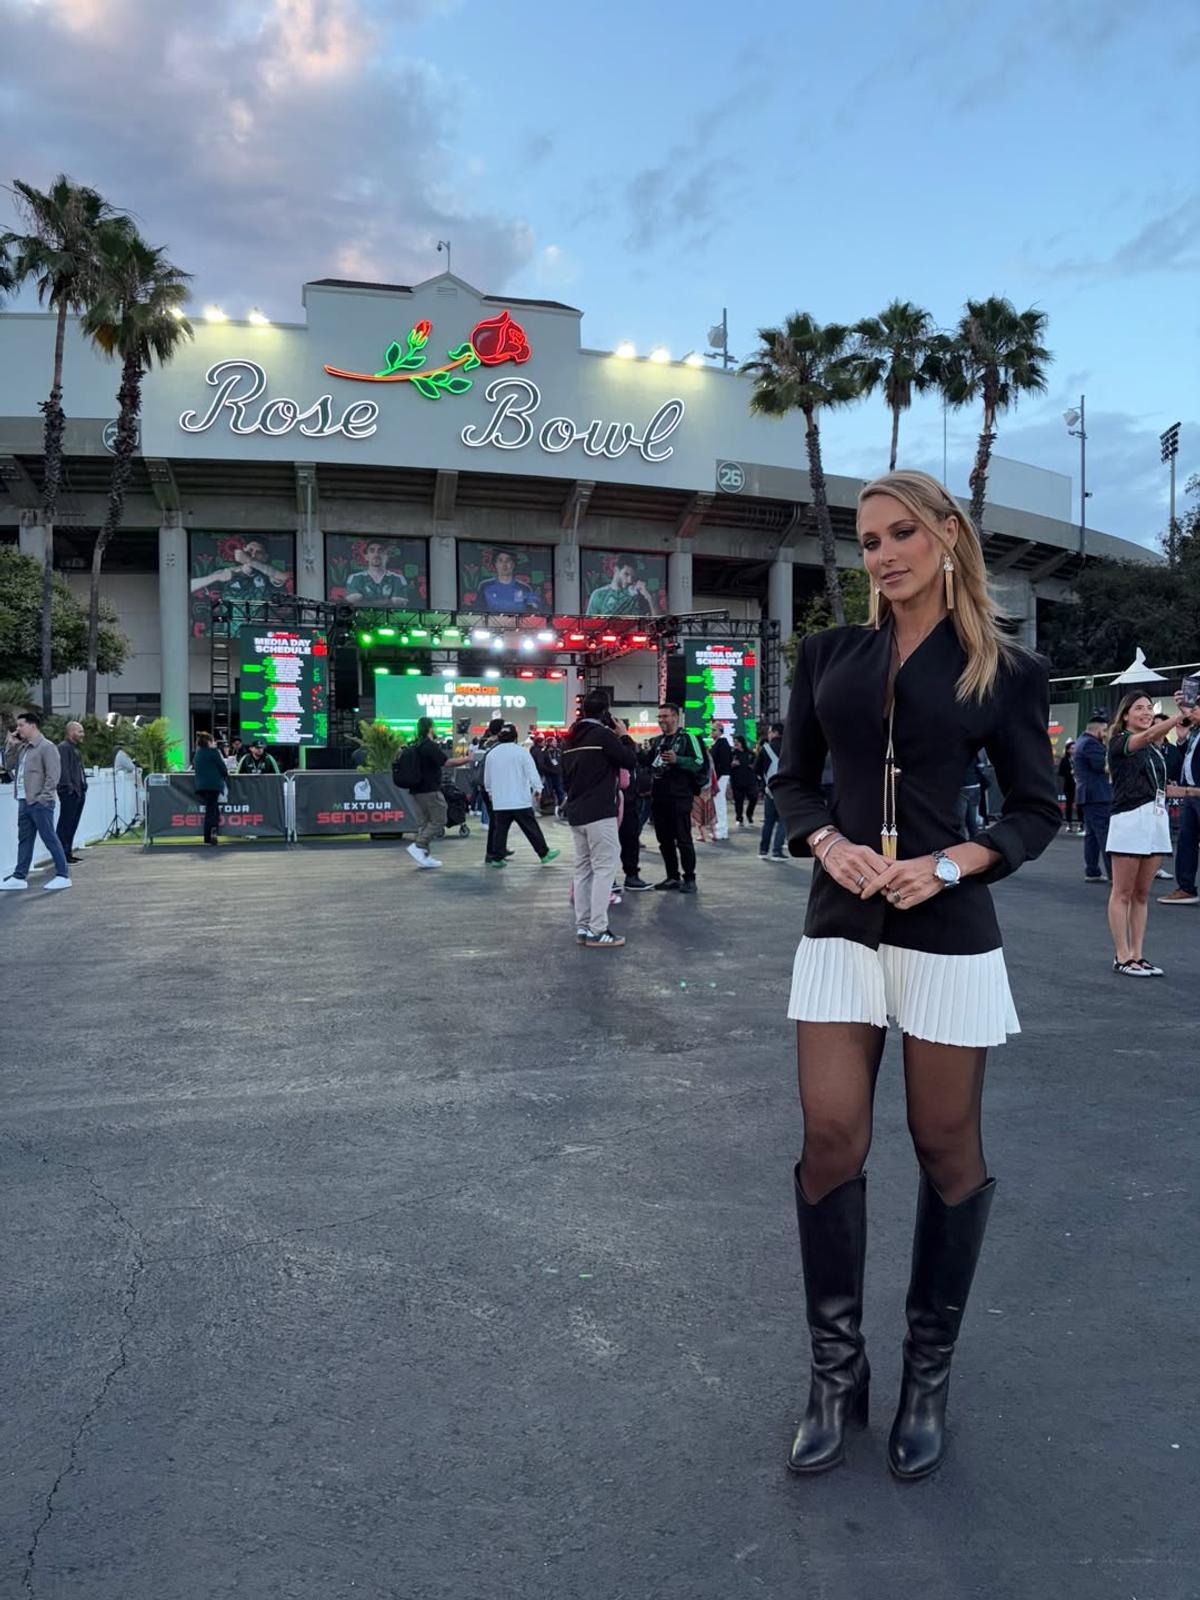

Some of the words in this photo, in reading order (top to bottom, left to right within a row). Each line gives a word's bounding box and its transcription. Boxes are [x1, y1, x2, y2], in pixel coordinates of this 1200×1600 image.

[179, 358, 379, 439] Rose
[461, 377, 685, 462] Bowl
[720, 468, 742, 486] 26
[254, 637, 289, 646] MEDIA
[290, 638, 311, 647] DAY
[255, 645, 311, 655] SCHEDULE
[416, 693, 501, 707] WELCOME
[503, 695, 526, 708] TO
[187, 804, 249, 813] METOUR
[333, 801, 391, 811] MEXTOUR
[228, 814, 264, 826] OFF
[316, 811, 369, 824] SEND
[370, 810, 405, 823] OFF
